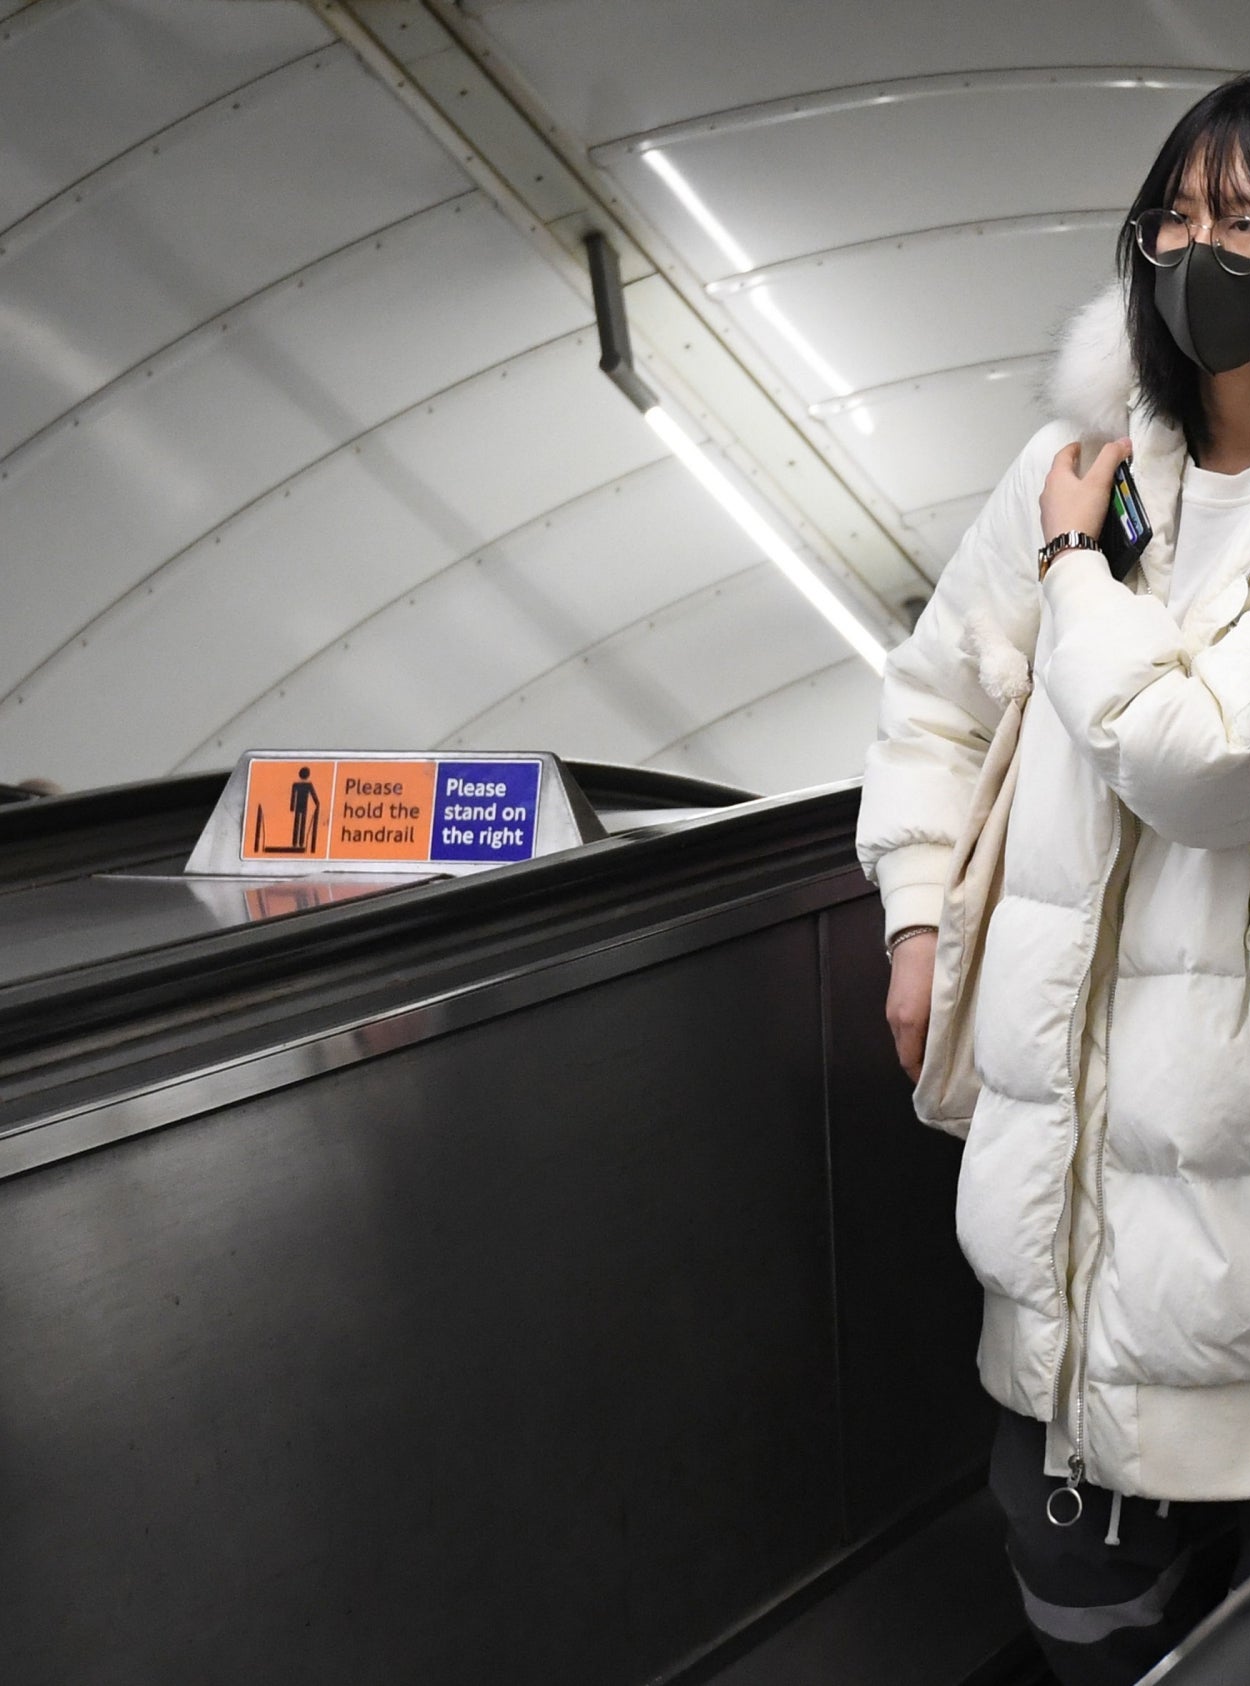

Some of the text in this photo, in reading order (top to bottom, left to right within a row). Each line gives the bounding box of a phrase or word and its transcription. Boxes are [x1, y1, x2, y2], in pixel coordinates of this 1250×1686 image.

[345, 778, 403, 796] Please
[446, 778, 507, 797] Please
[343, 802, 420, 820] hold the
[444, 803, 527, 821] stand on
[341, 826, 415, 844] handrail
[442, 827, 524, 849] the right
